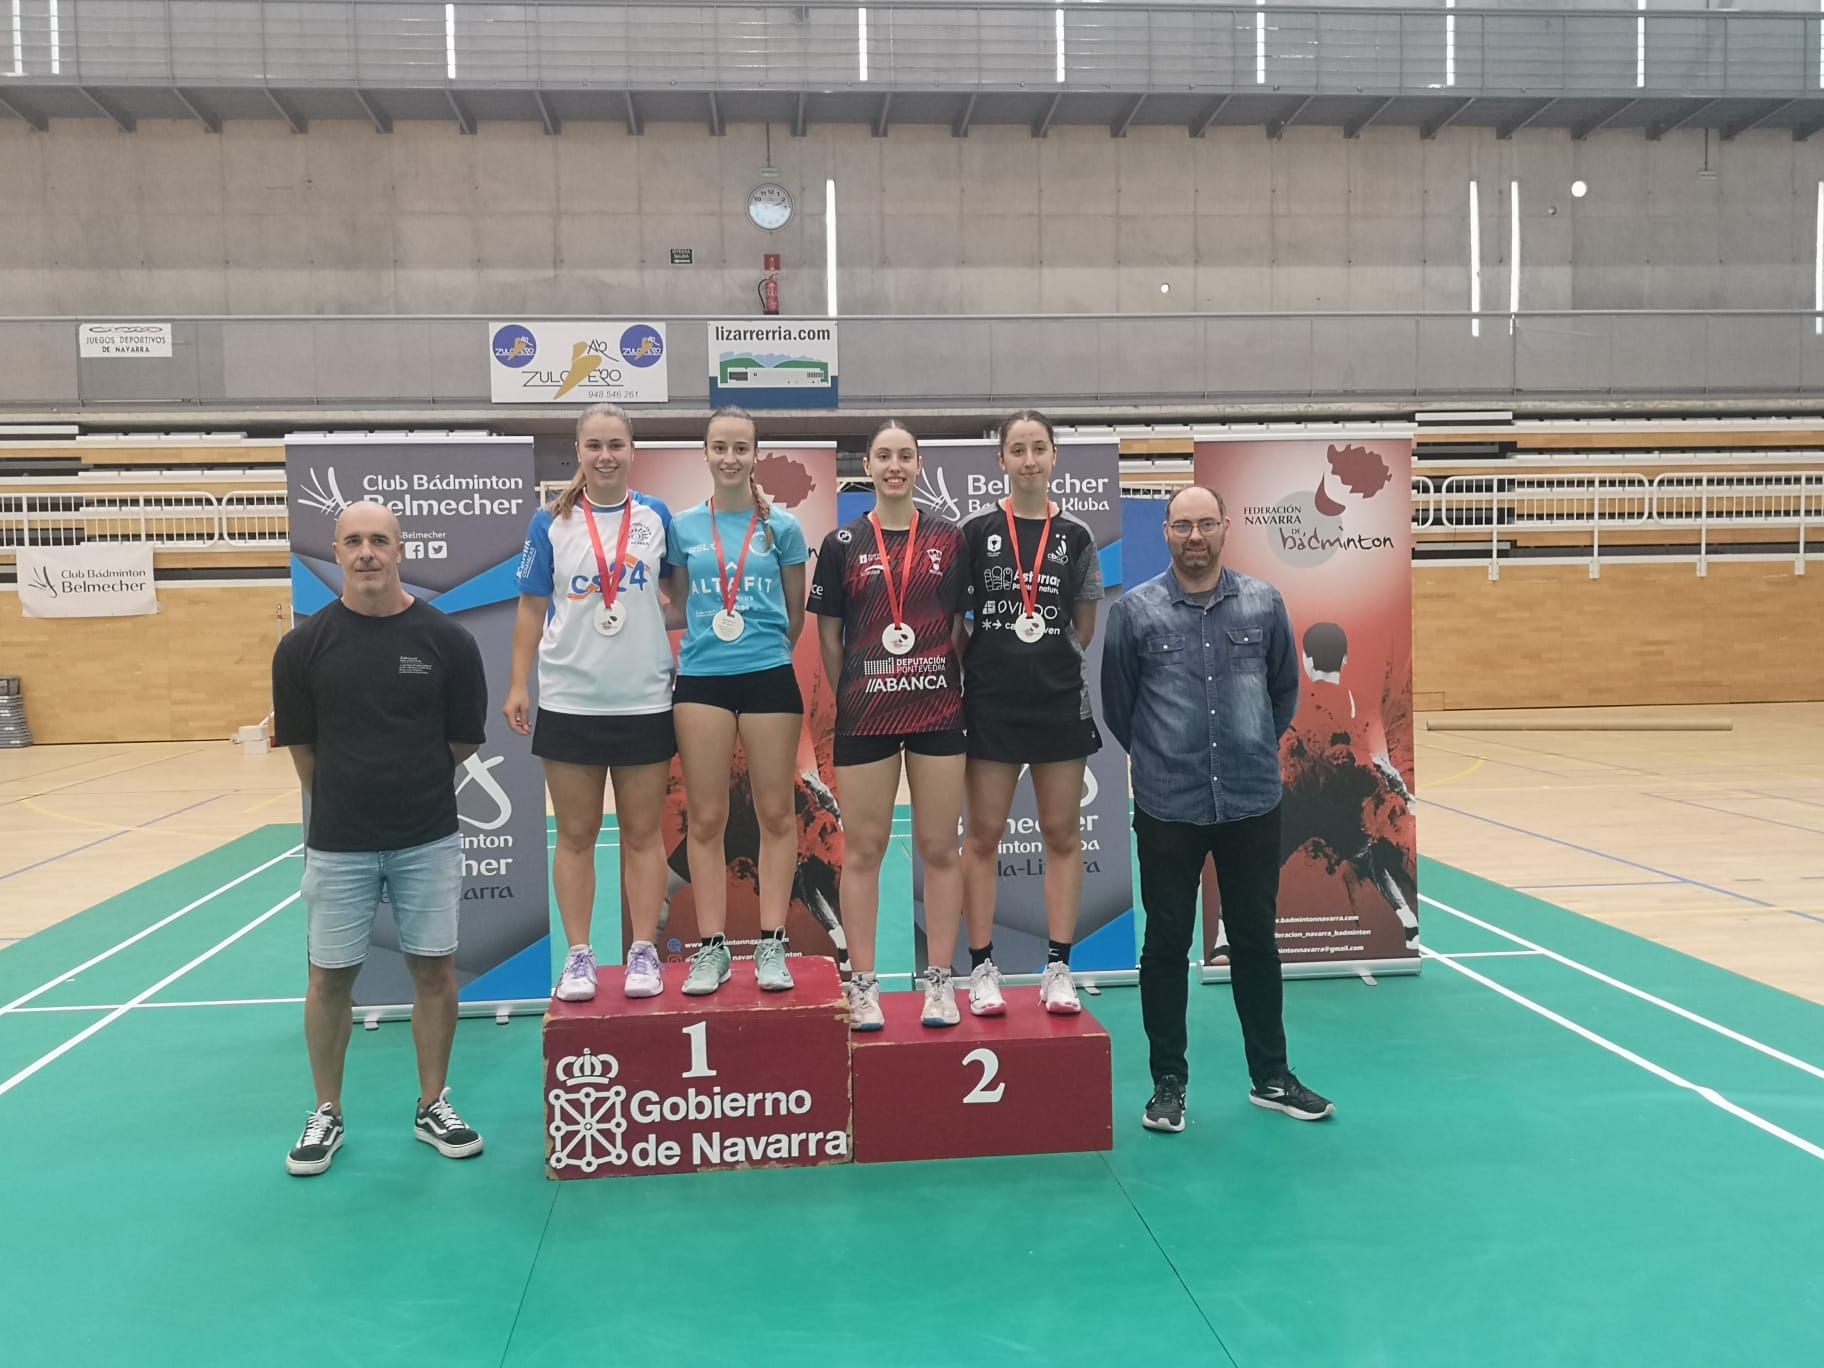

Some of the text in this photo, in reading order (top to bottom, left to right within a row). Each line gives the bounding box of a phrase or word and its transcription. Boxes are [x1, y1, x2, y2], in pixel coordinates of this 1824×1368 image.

[86, 336, 166, 344] JUEGOS DEPORTIVOS
[716, 326, 831, 341] lizarrerria.com
[588, 390, 639, 399] 948 546 261
[363, 474, 523, 491] Club Bádminton
[967, 473, 1109, 495] Belcher
[1062, 497, 1110, 511] Kluba
[1244, 504, 1302, 515] FEDERACIÓN
[1245, 516, 1302, 525] NAVARRA
[61, 569, 85, 579] Club
[62, 580, 146, 593] Belmecher
[896, 655, 946, 666] DEPUTACIÓN
[896, 664, 946, 673] PONTEVEDRA
[682, 1020, 717, 1078] 1
[962, 1048, 1006, 1103] 2
[630, 1086, 812, 1123] Gobierno
[632, 1130, 847, 1166] de Navarra
